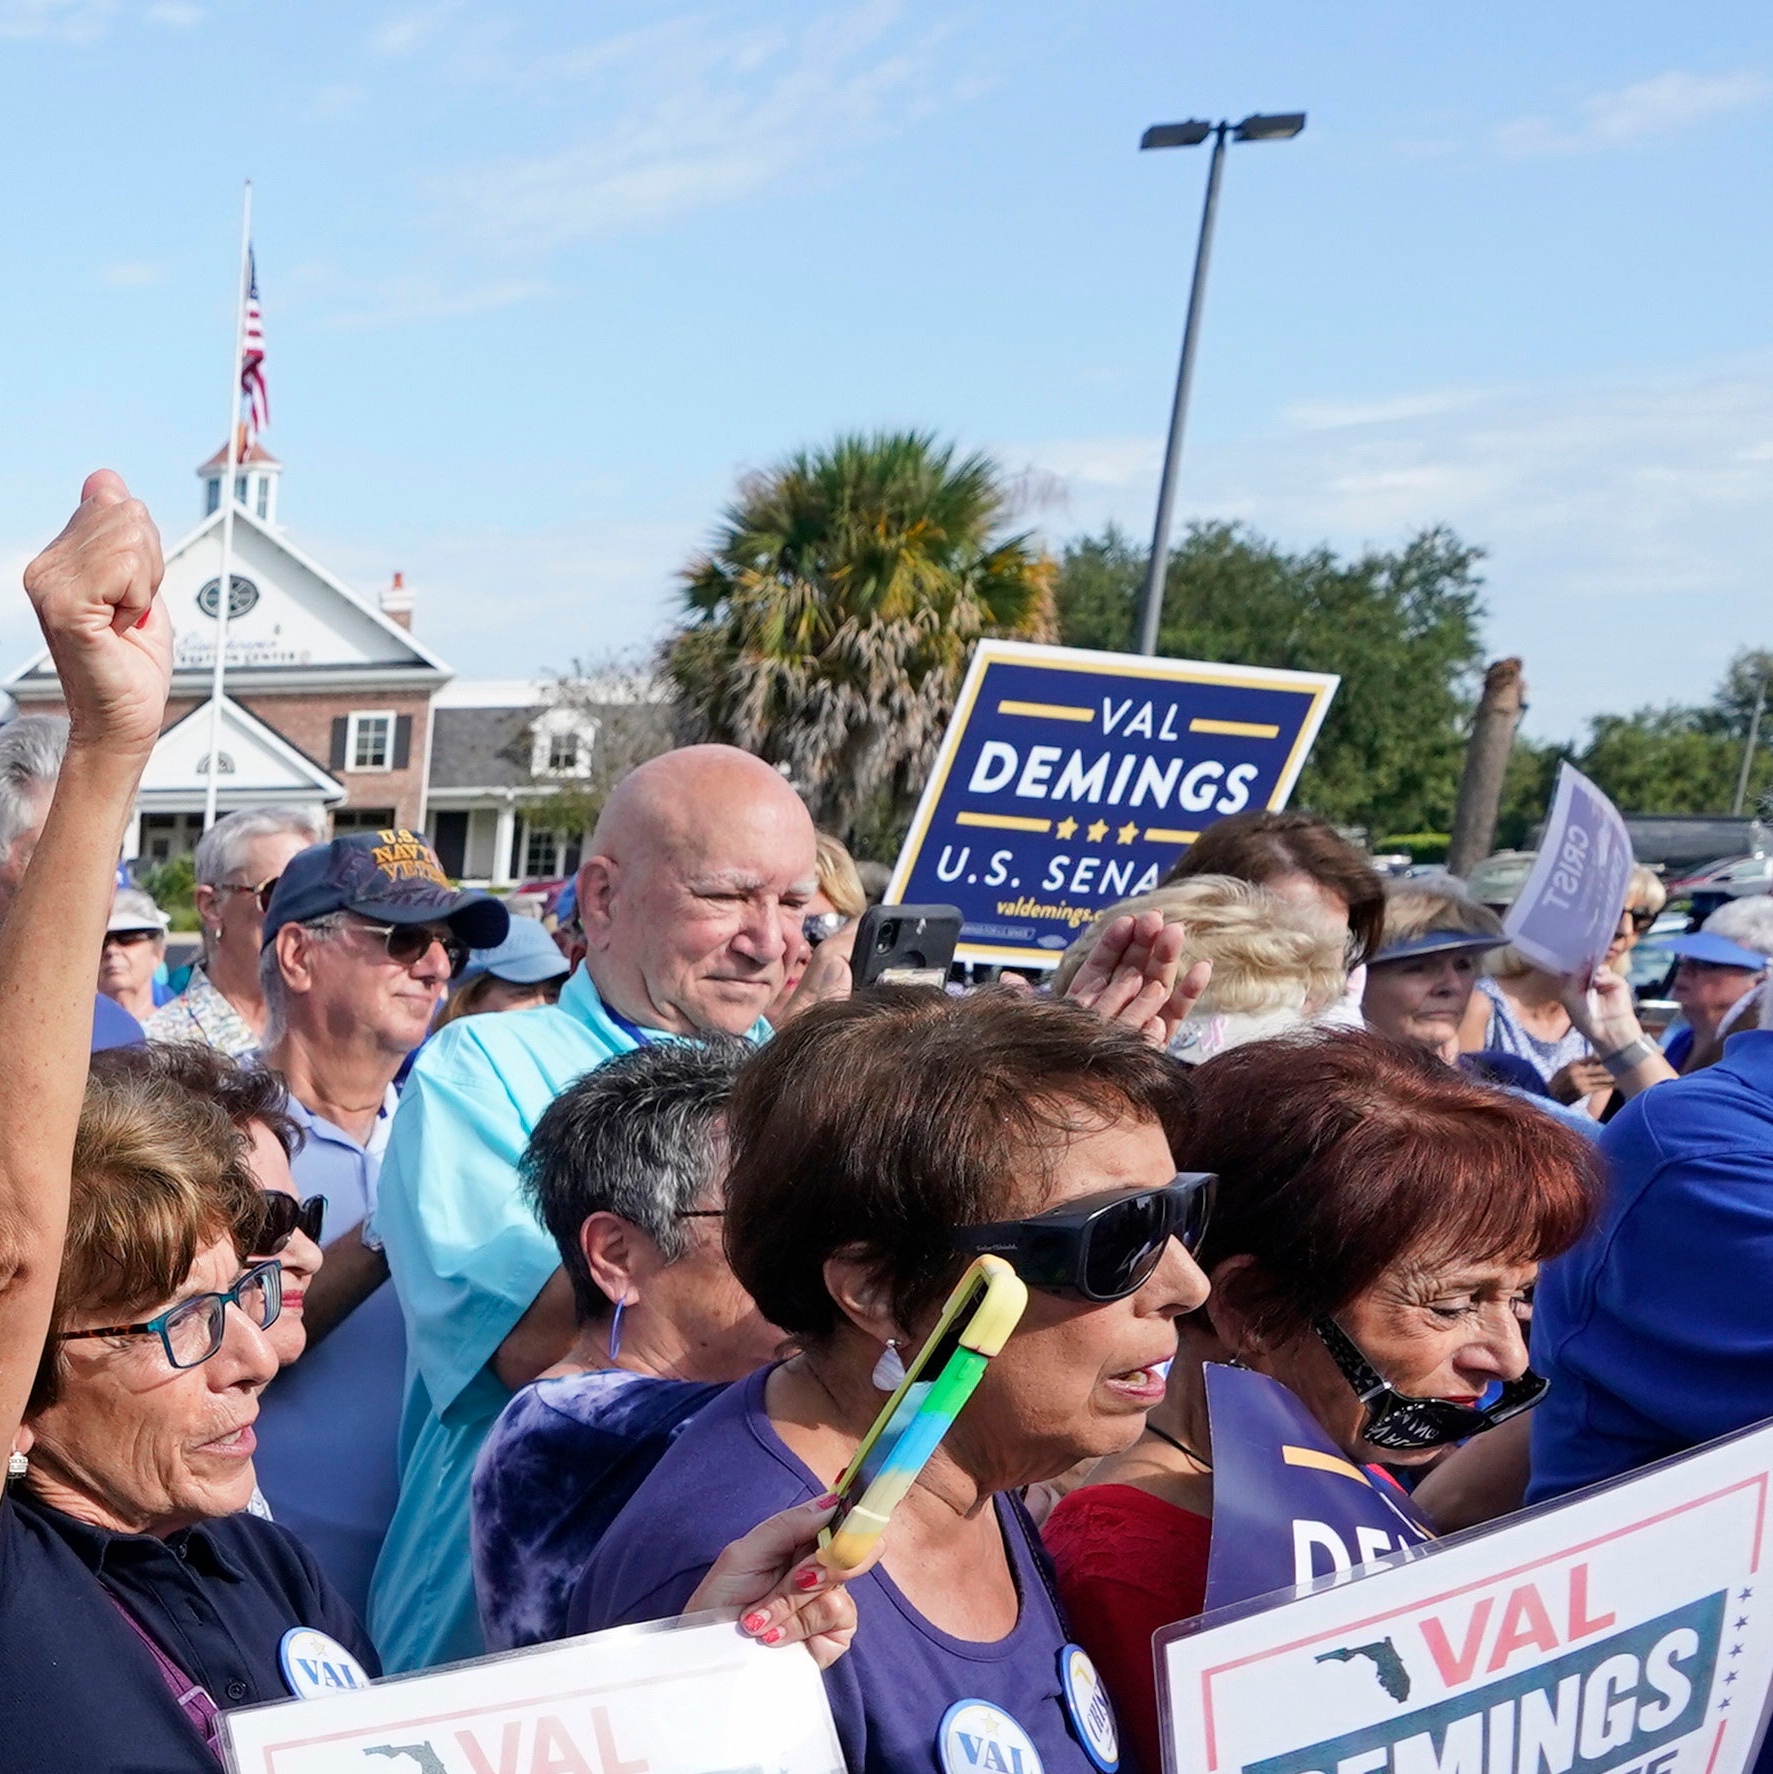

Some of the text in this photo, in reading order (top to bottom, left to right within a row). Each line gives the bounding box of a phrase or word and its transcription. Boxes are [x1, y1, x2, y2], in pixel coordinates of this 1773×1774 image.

[1102, 697, 1179, 742] VAL
[968, 740, 1259, 814] DEMINGS
[371, 843, 431, 864] NAVY
[937, 846, 1020, 888] U.S.
[1420, 1564, 1616, 1689] VAL
